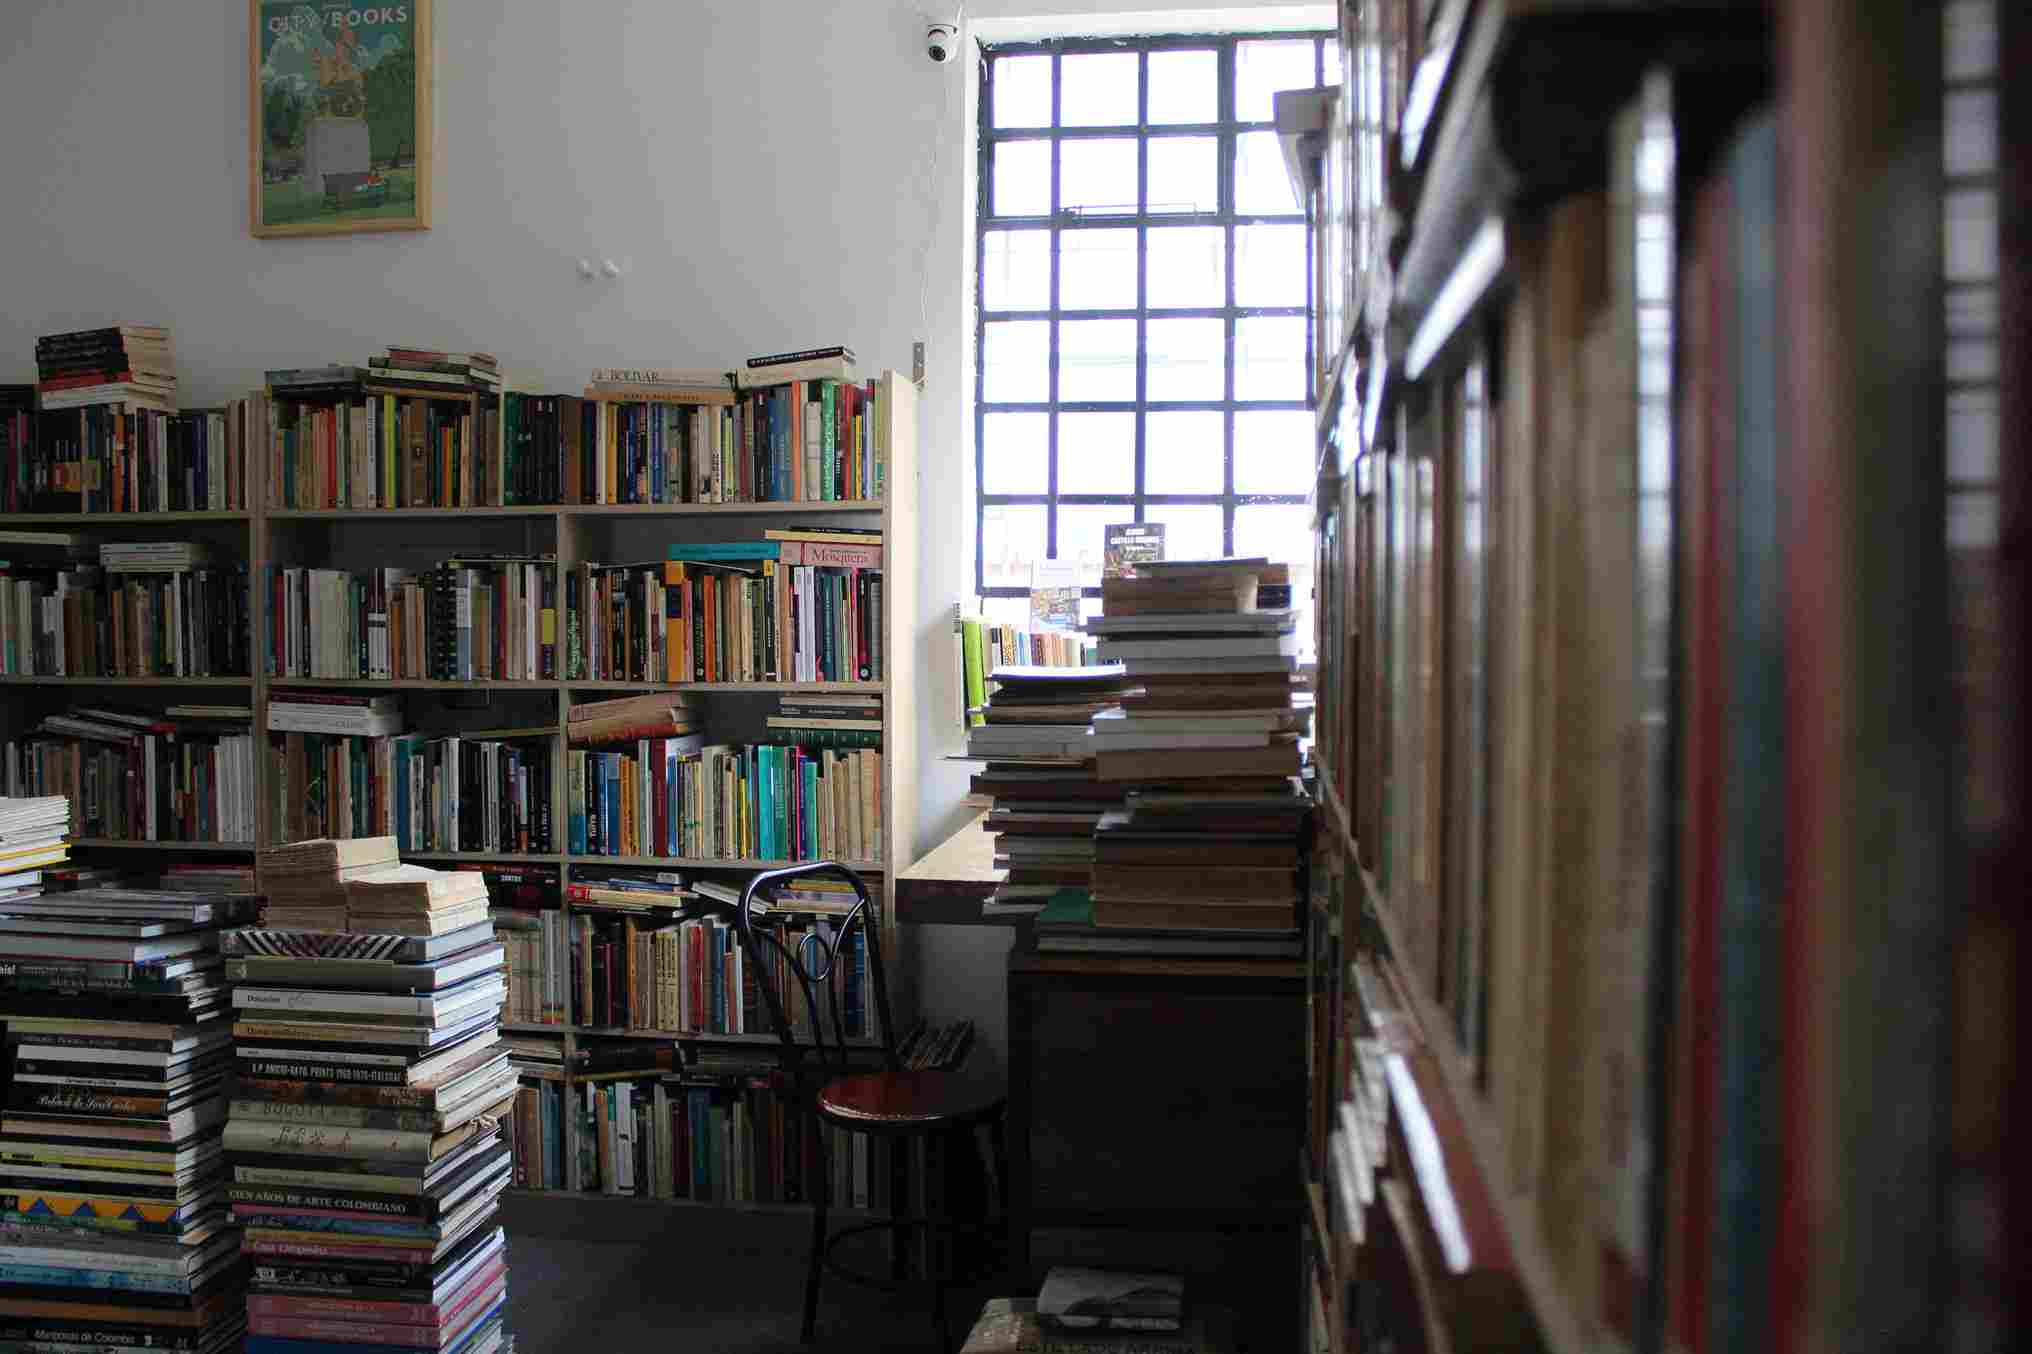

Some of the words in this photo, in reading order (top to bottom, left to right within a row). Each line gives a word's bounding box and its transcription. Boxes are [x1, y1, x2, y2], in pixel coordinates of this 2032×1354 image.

[331, 7, 407, 28] BOOKS
[229, 1190, 253, 1202] CIEN
[286, 1193, 302, 1206] DE
[304, 1195, 332, 1208] ARTE
[334, 1198, 407, 1214] COLOMBIANO
